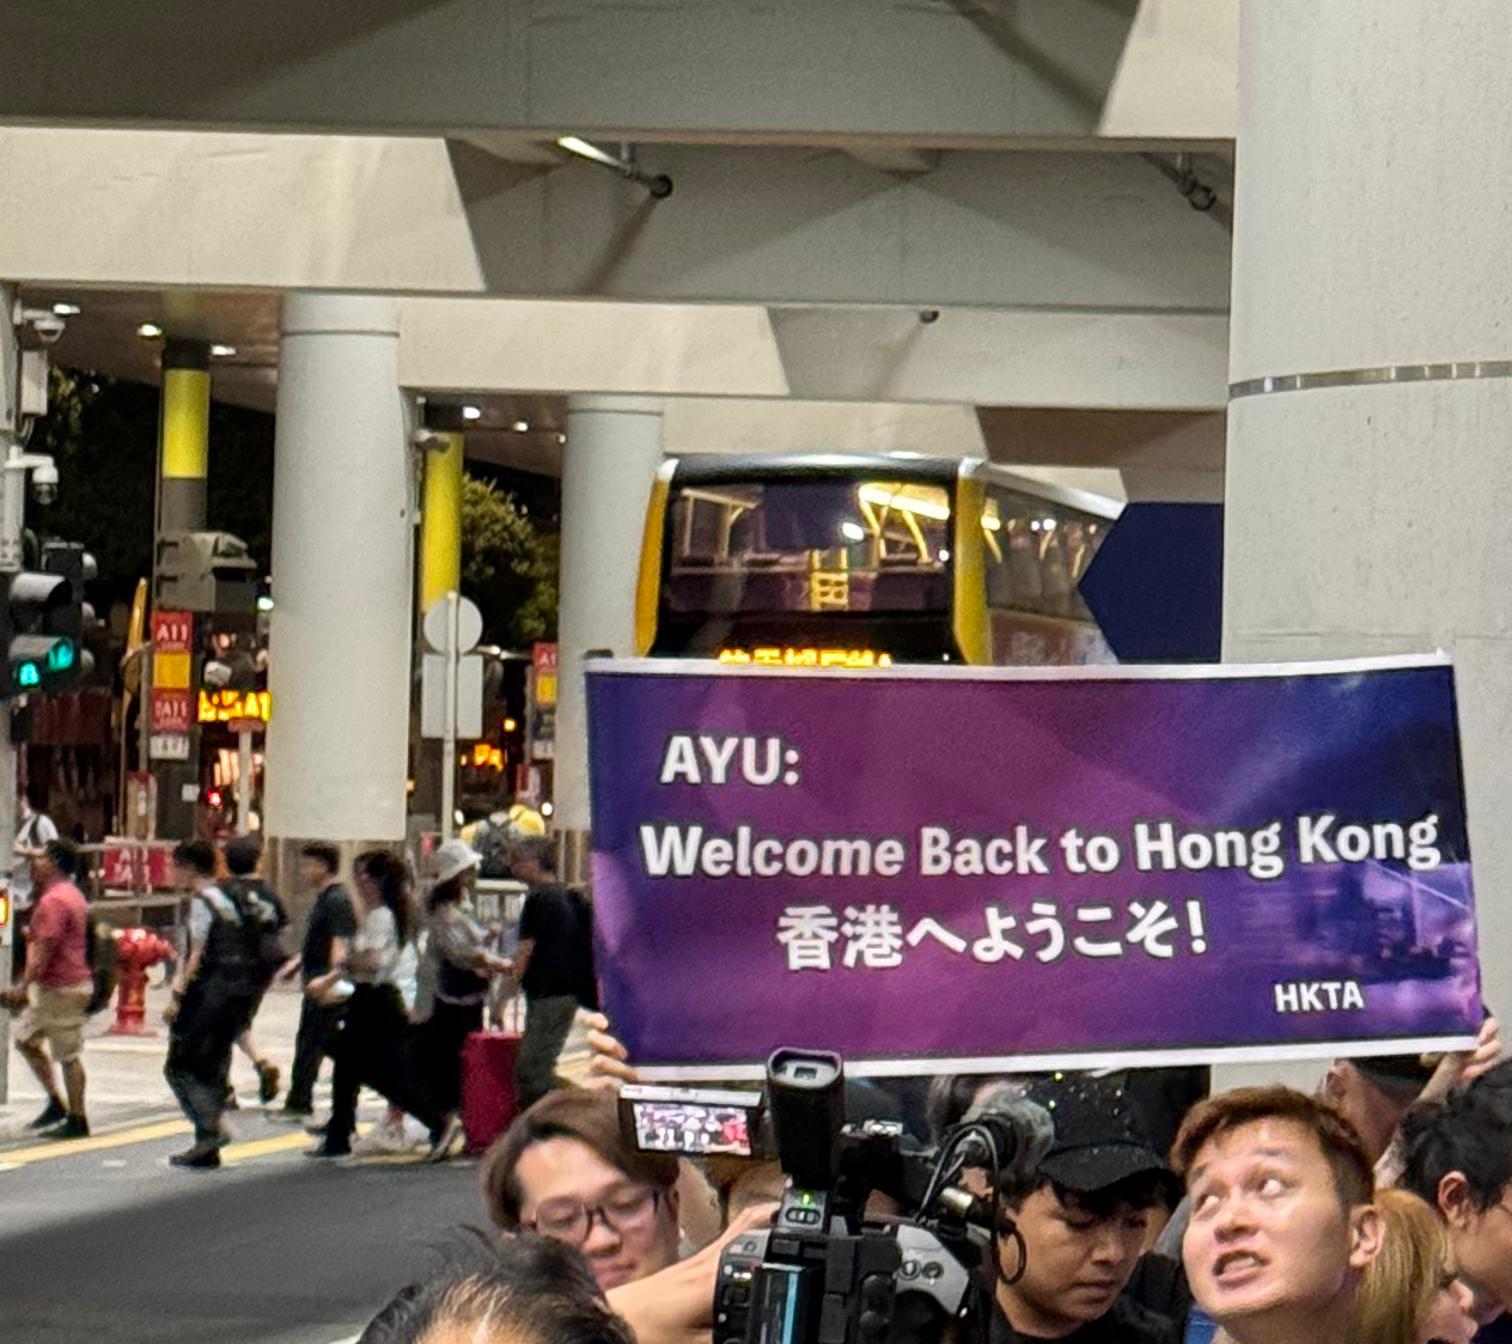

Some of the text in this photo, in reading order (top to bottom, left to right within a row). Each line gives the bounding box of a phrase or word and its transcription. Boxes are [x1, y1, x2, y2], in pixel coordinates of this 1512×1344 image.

[660, 734, 801, 786] AYU:
[640, 812, 1441, 880] Welcome Back to Hong Kong
[1274, 981, 1365, 1014] HKTA
